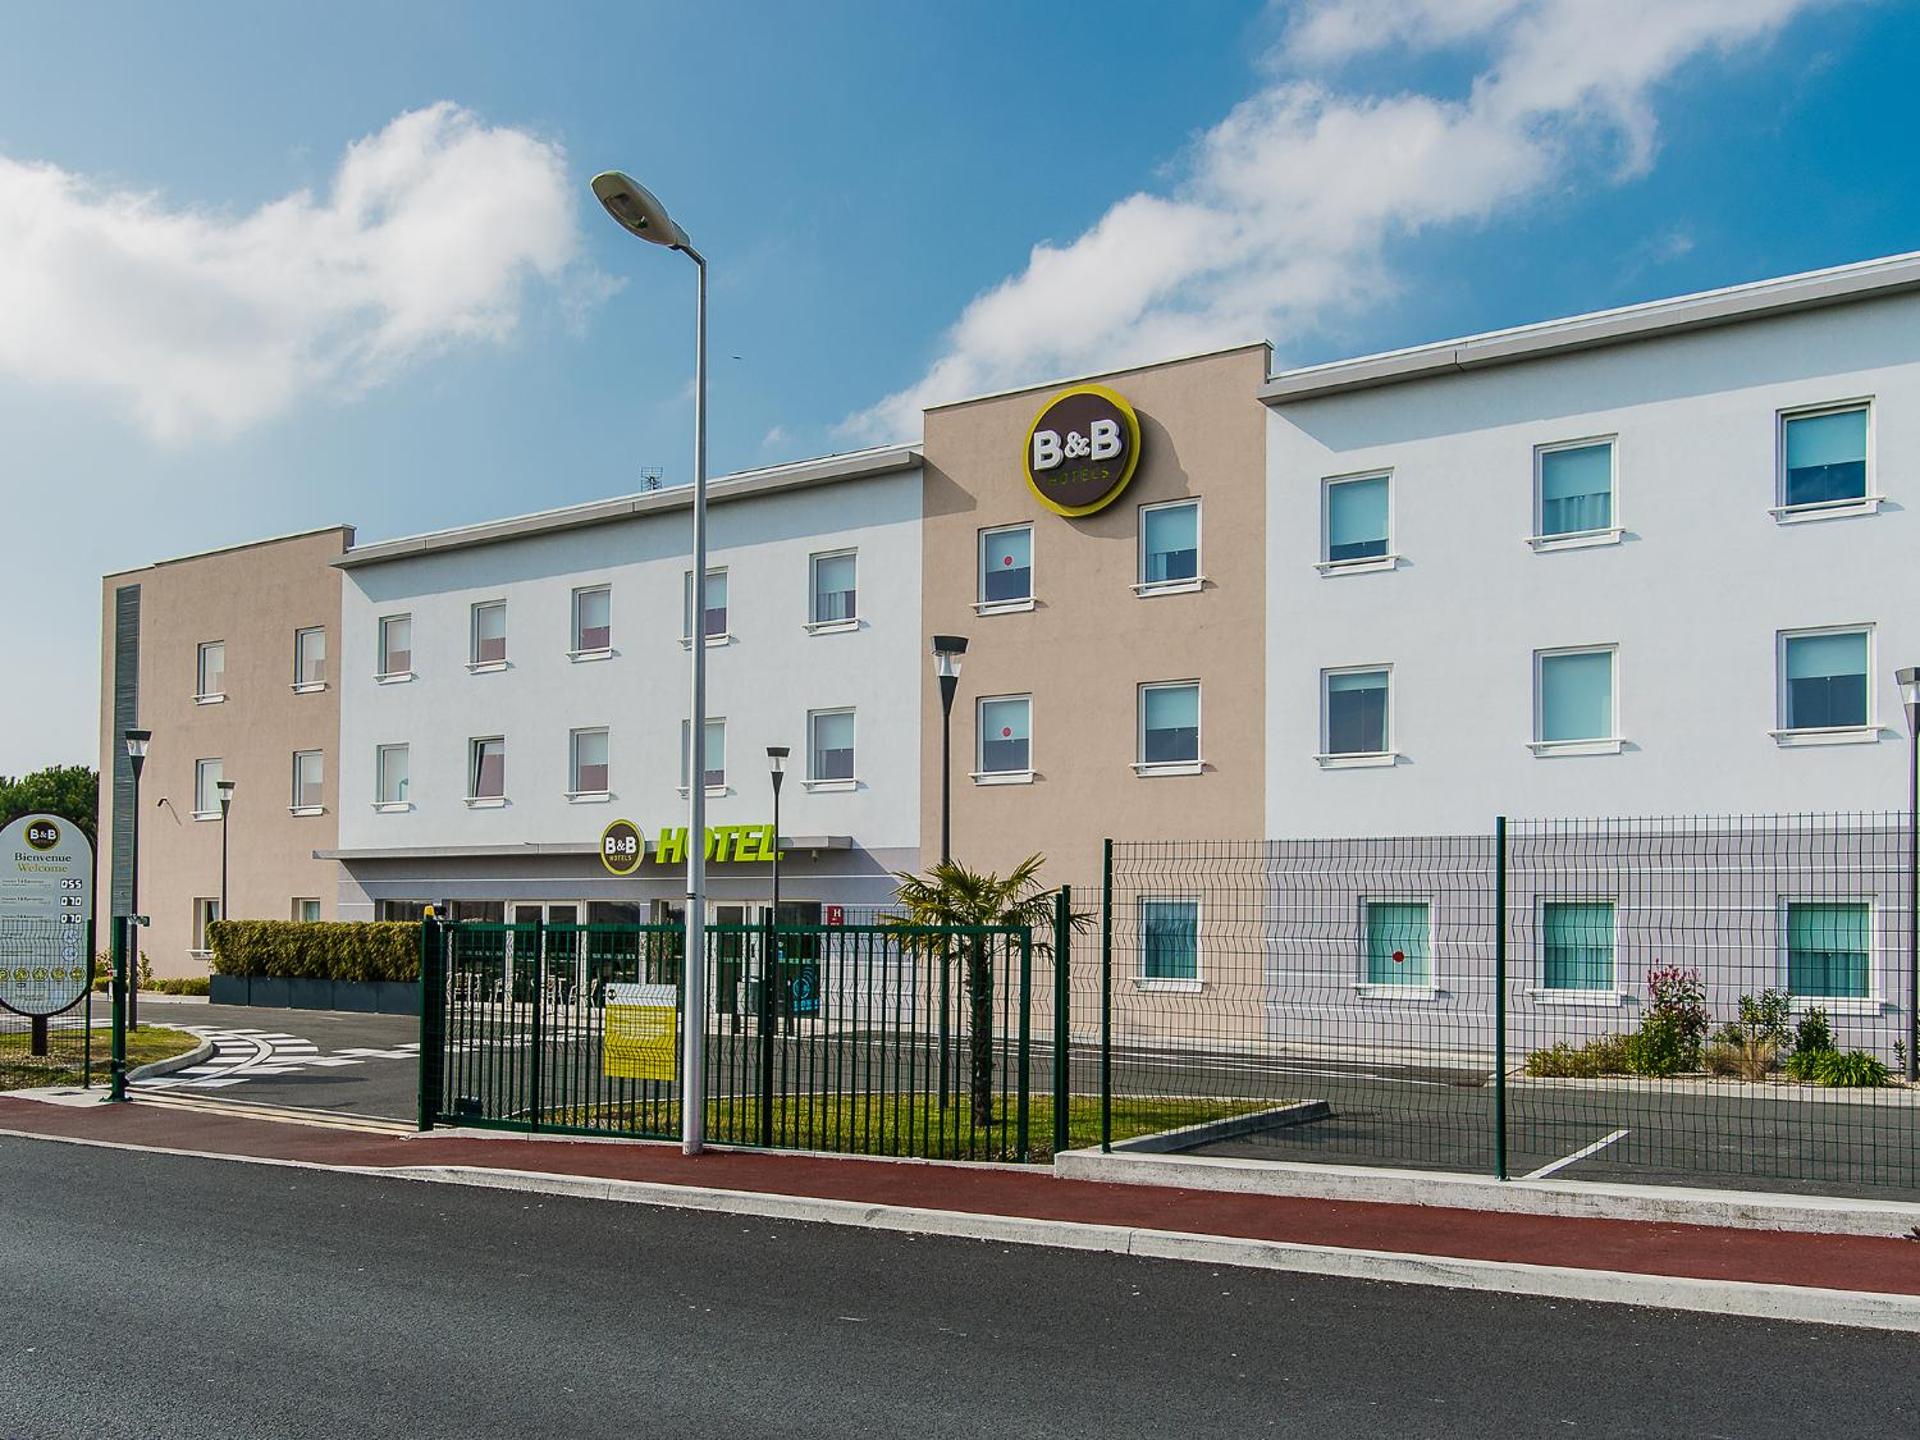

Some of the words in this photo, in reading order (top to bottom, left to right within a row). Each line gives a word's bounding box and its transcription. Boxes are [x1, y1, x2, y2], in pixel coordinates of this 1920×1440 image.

[1033, 419, 1122, 471] B&B
[1047, 467, 1110, 487] HOTELS
[30, 828, 57, 840] B&B
[605, 836, 637, 855] B&B
[14, 852, 72, 862] Bienvenue
[17, 862, 69, 873] Welcome
[60, 879, 82, 889] 055
[60, 896, 82, 906] 070
[60, 914, 82, 924] 070
